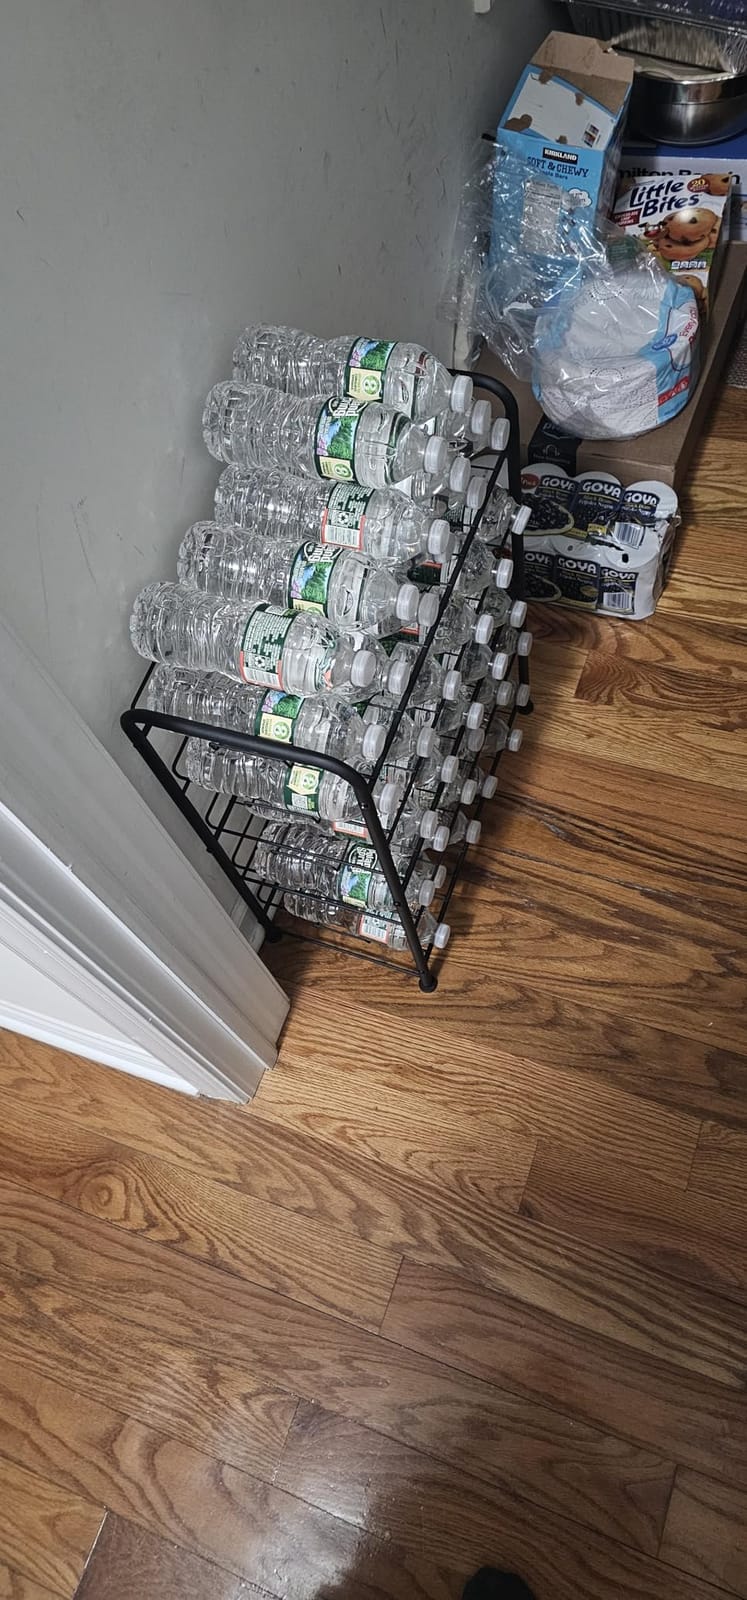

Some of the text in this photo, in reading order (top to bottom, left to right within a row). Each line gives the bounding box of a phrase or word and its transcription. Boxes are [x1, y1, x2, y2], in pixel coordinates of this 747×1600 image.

[544, 149, 577, 161] KIRKLAND
[547, 161, 556, 171] &
[556, 163, 589, 178] CHEWY
[630, 179, 684, 208] Little
[642, 194, 700, 217] Bites
[542, 477, 576, 490] GOYA
[582, 482, 621, 498] GOYA
[624, 492, 657, 505] GOYA
[524, 552, 551, 564] OYA
[558, 558, 597, 574] GOYA
[601, 568, 636, 580] GOYA
